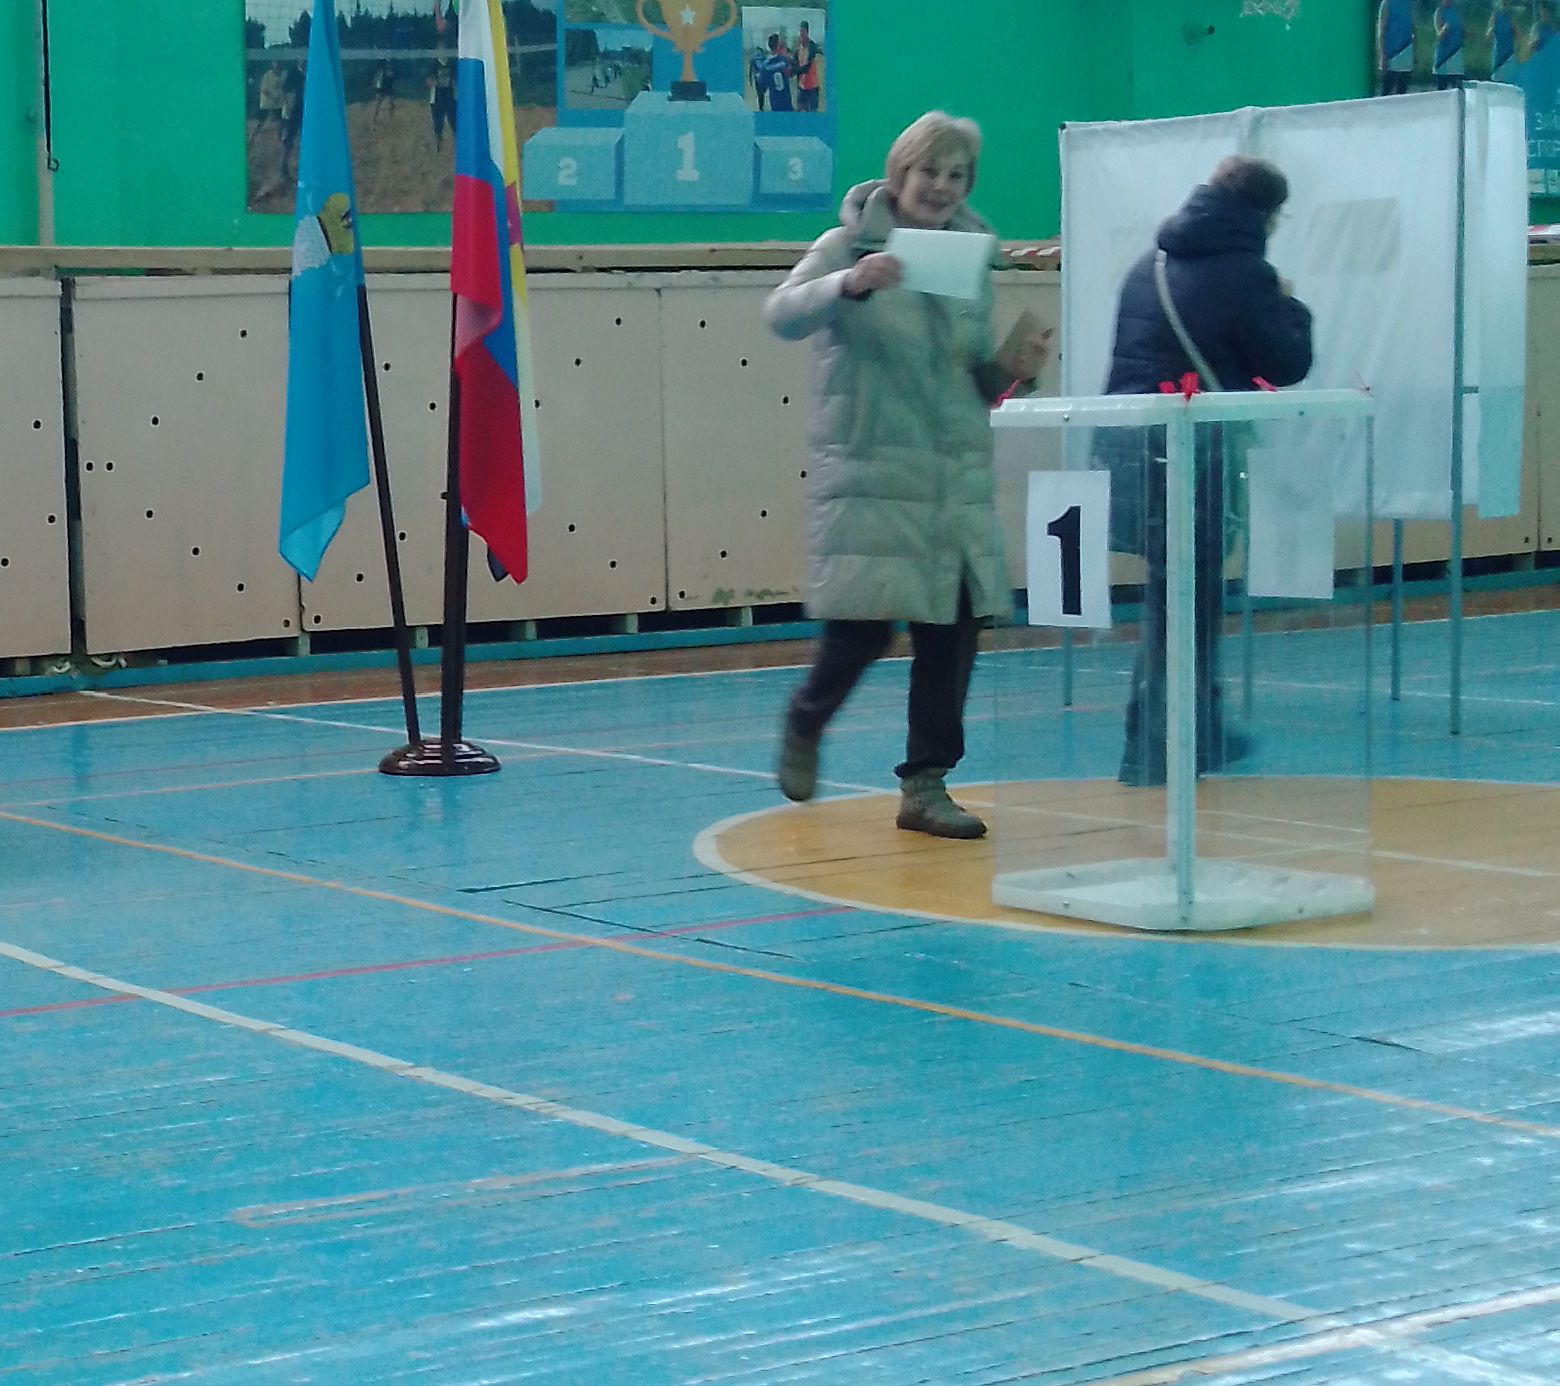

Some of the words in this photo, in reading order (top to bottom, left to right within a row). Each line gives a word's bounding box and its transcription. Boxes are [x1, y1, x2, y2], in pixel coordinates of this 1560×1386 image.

[557, 157, 577, 186] 2
[676, 132, 699, 181] 1
[790, 157, 803, 181] 3
[1046, 505, 1082, 616] 1
